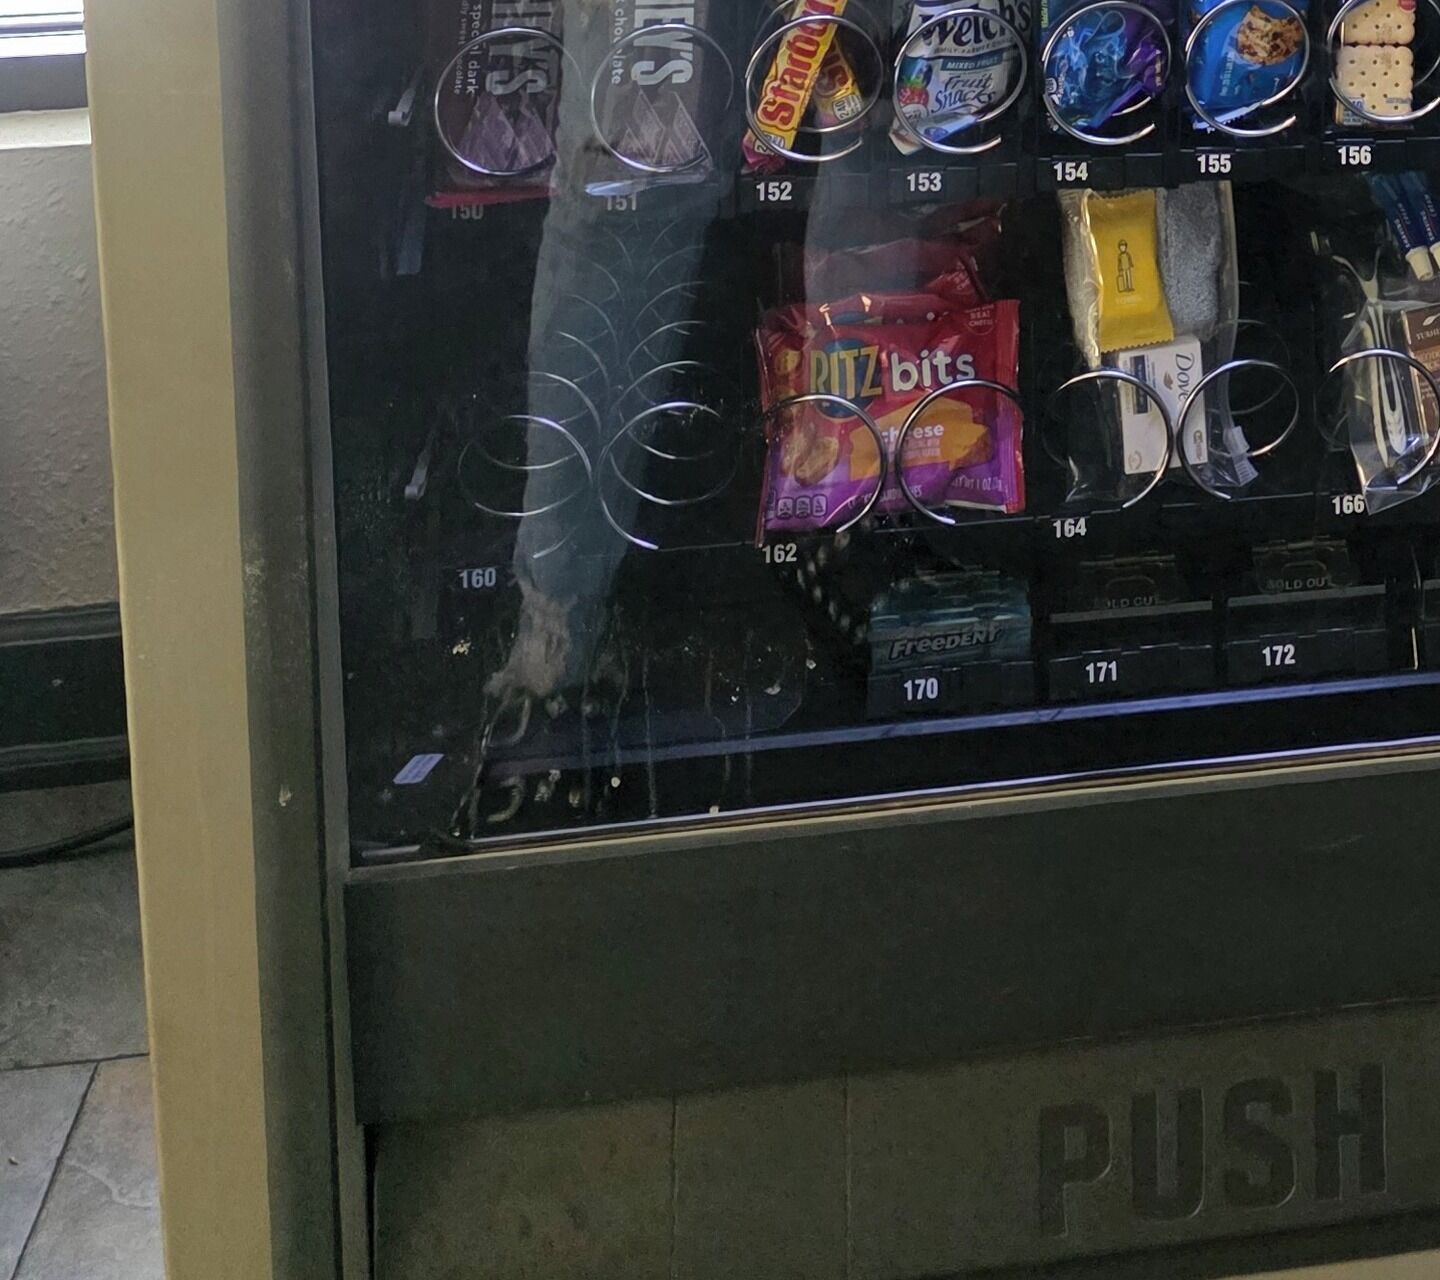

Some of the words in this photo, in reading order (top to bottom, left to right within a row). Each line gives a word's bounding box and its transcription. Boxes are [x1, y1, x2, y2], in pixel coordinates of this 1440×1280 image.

[465, 59, 481, 97] dark
[944, 72, 994, 92] Fruit
[931, 88, 997, 114] Snacks
[1197, 154, 1232, 174] 155
[1338, 145, 1372, 166] 156
[1053, 161, 1089, 181] 154
[755, 181, 793, 202] 152
[906, 172, 942, 192] 153
[451, 202, 485, 221] 150
[606, 192, 639, 212] 151
[809, 344, 883, 400] RITZ
[890, 349, 976, 392] bits
[1174, 352, 1196, 402] Dove
[1331, 494, 1365, 514] 166
[1053, 518, 1087, 539] 164
[761, 543, 798, 564] 162
[458, 566, 496, 590] 160
[1261, 643, 1296, 667] 172
[1085, 660, 1118, 683] 171
[903, 677, 939, 702] 170
[1038, 1062, 1388, 1239] PUSH
